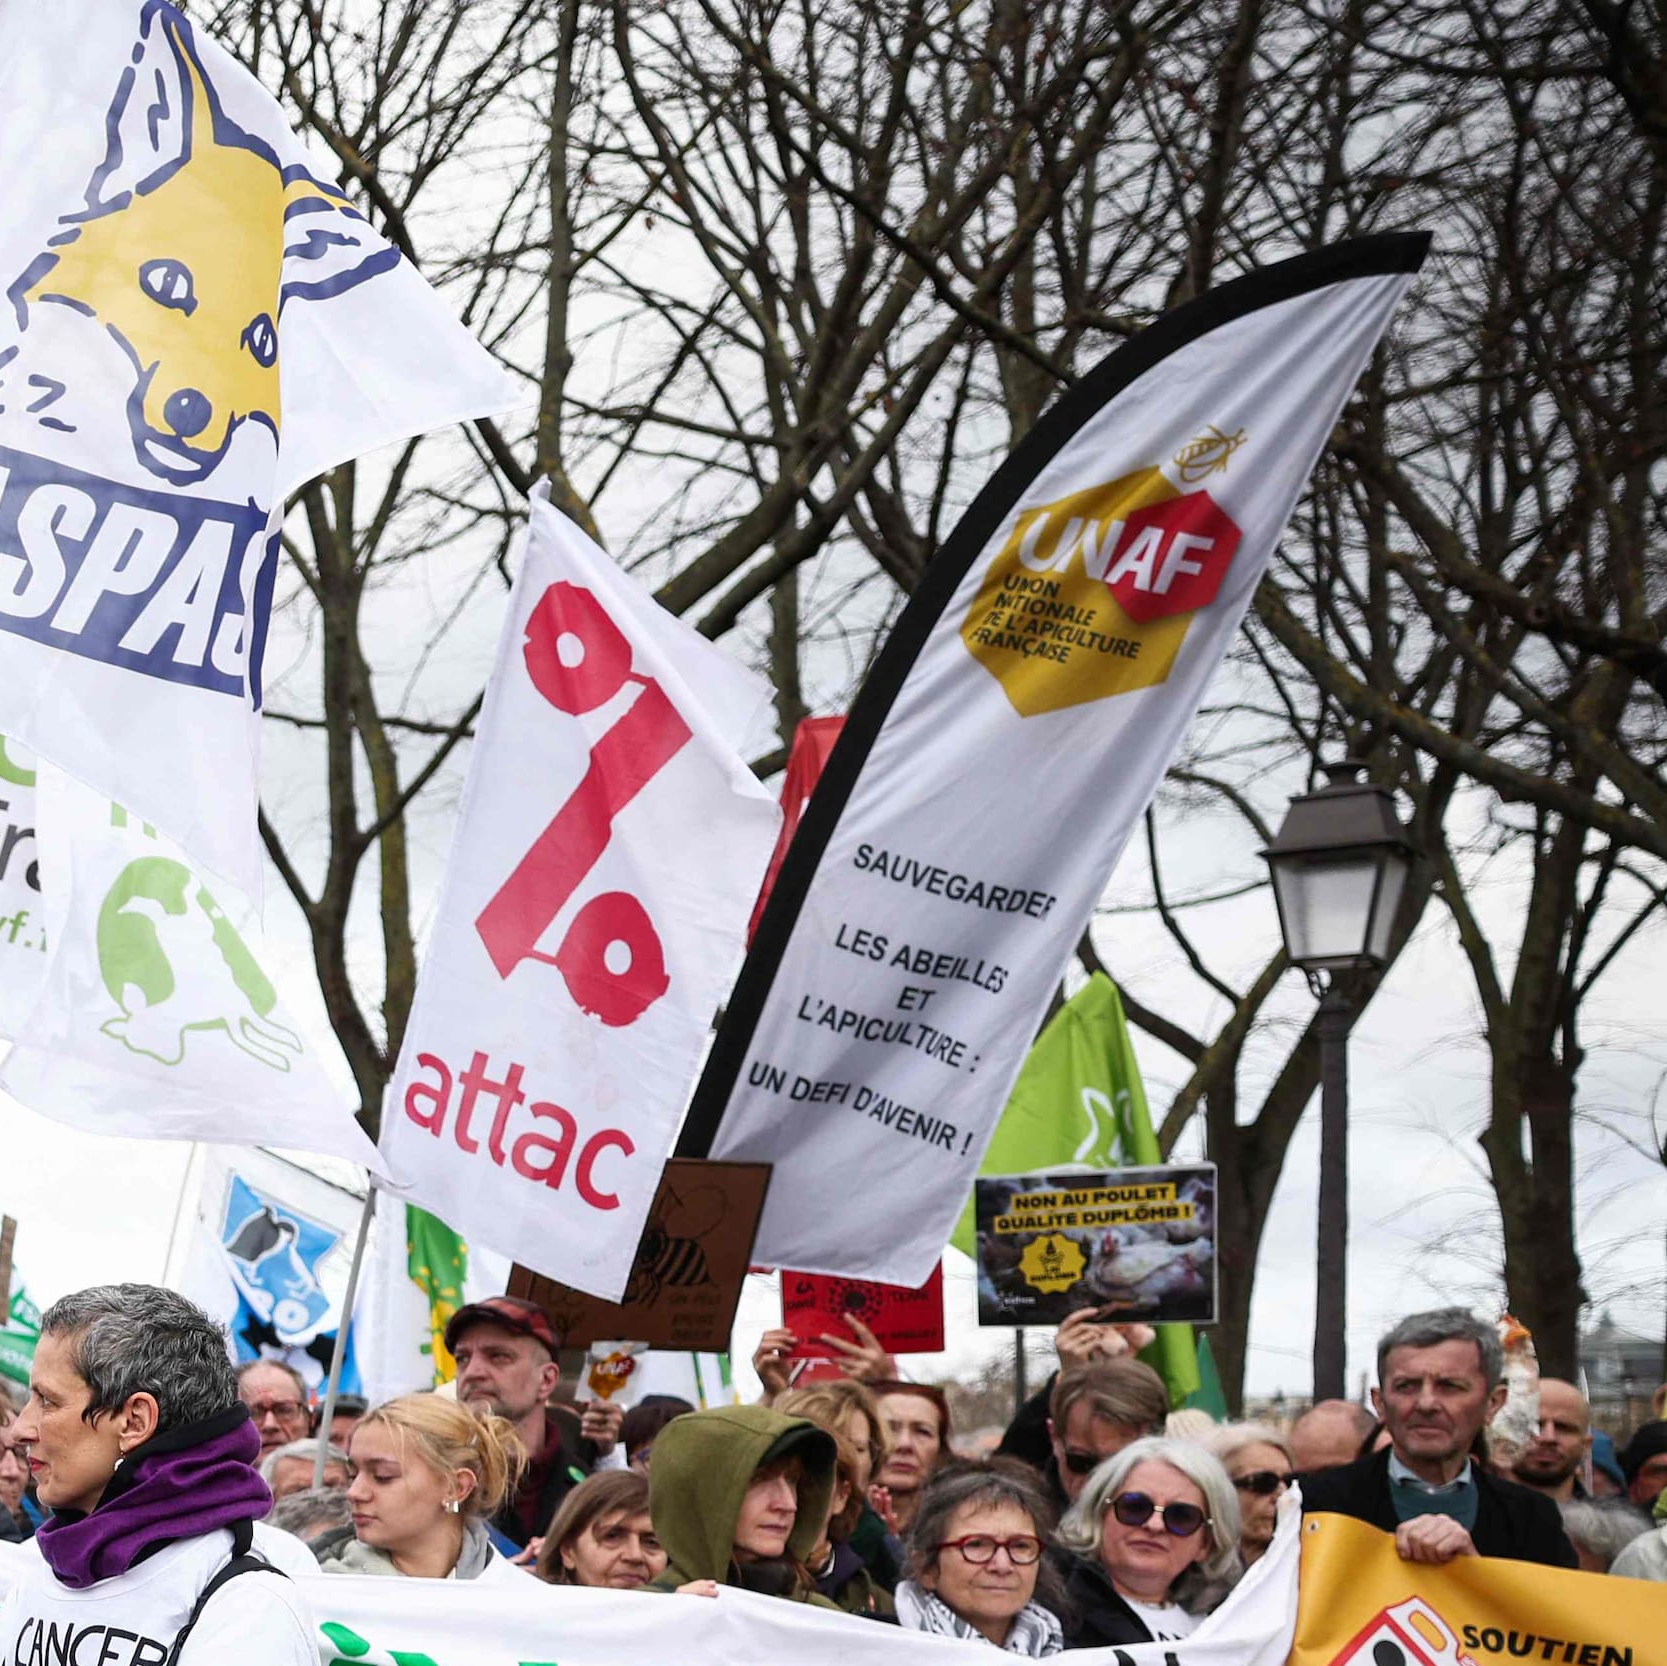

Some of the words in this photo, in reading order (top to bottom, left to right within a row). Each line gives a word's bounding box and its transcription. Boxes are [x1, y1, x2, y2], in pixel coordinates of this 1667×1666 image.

[1019, 512, 1215, 595] UNAF
[835, 923, 890, 961] LES
[890, 944, 1010, 994] ABEILLES
[797, 994, 967, 1068] L'APICULTURE
[896, 985, 937, 1012] ET
[403, 1050, 636, 1212] attac
[748, 1061, 787, 1094] UN
[790, 1075, 852, 1105] DEFI
[853, 1085, 958, 1151] D'AVENIR
[960, 1132, 974, 1157] !
[1016, 1195, 1058, 1210] NON
[1062, 1192, 1089, 1206] AU
[1093, 1186, 1170, 1204] POULET
